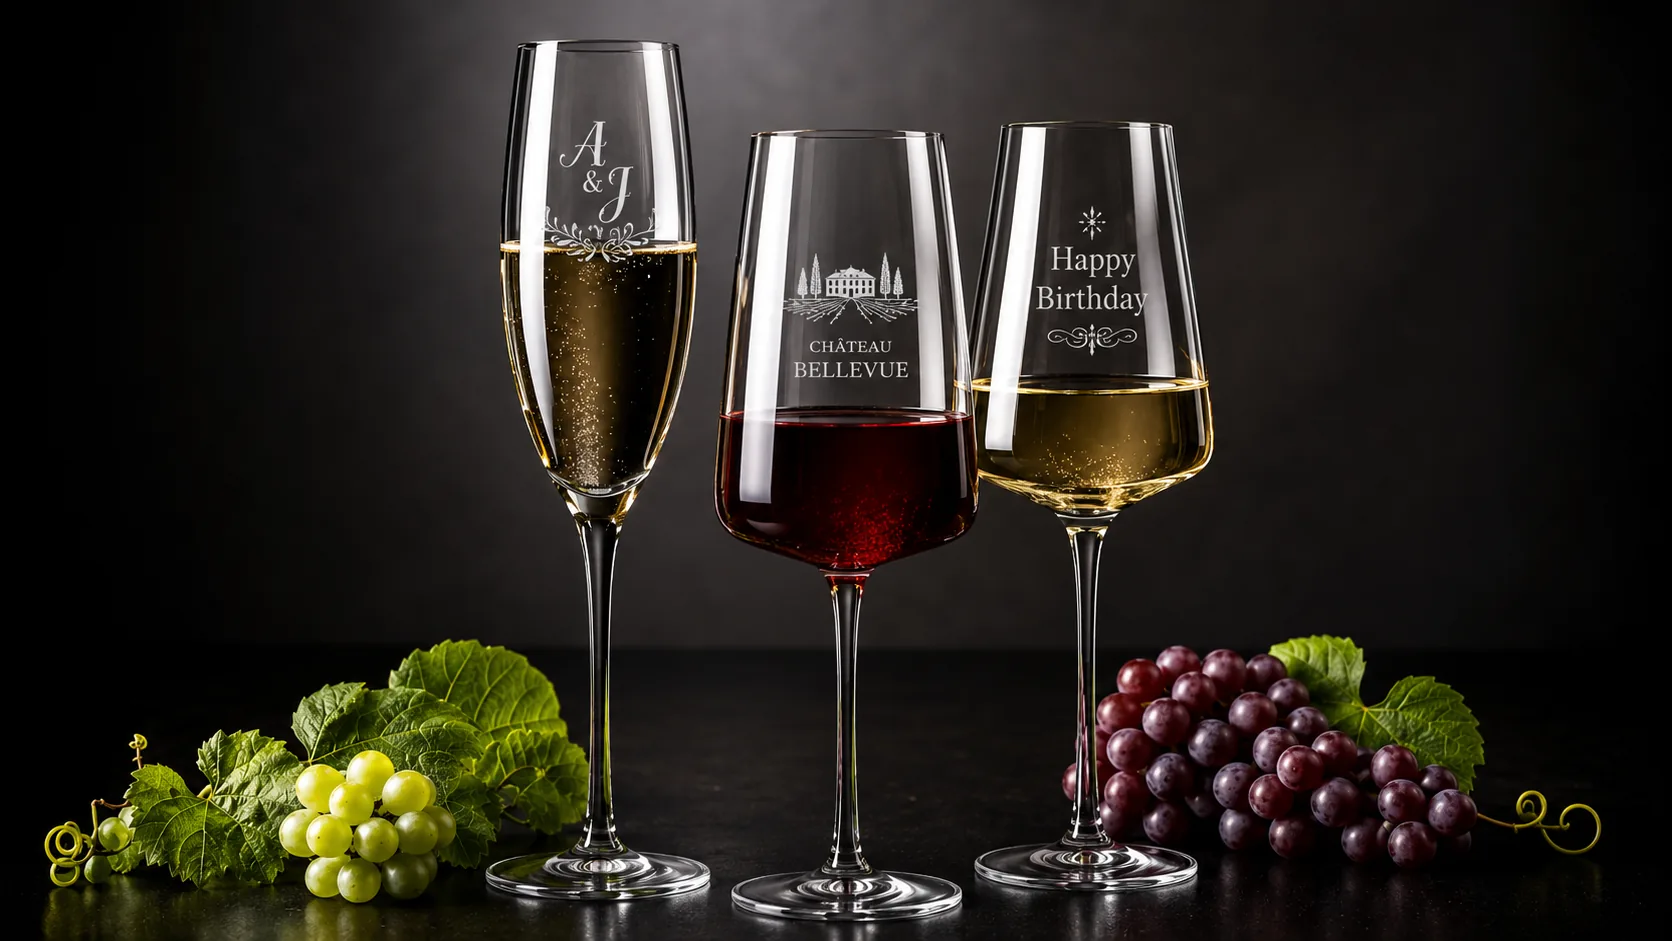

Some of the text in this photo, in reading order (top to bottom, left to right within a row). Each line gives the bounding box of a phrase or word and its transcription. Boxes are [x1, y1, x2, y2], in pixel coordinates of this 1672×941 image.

[559, 120, 607, 168] A
[582, 166, 634, 224] & J
[1050, 246, 1136, 278] Happy
[1036, 285, 1149, 316] Birthday
[809, 337, 892, 353] CHÂTEAU
[794, 361, 909, 378] BELLEVUE
